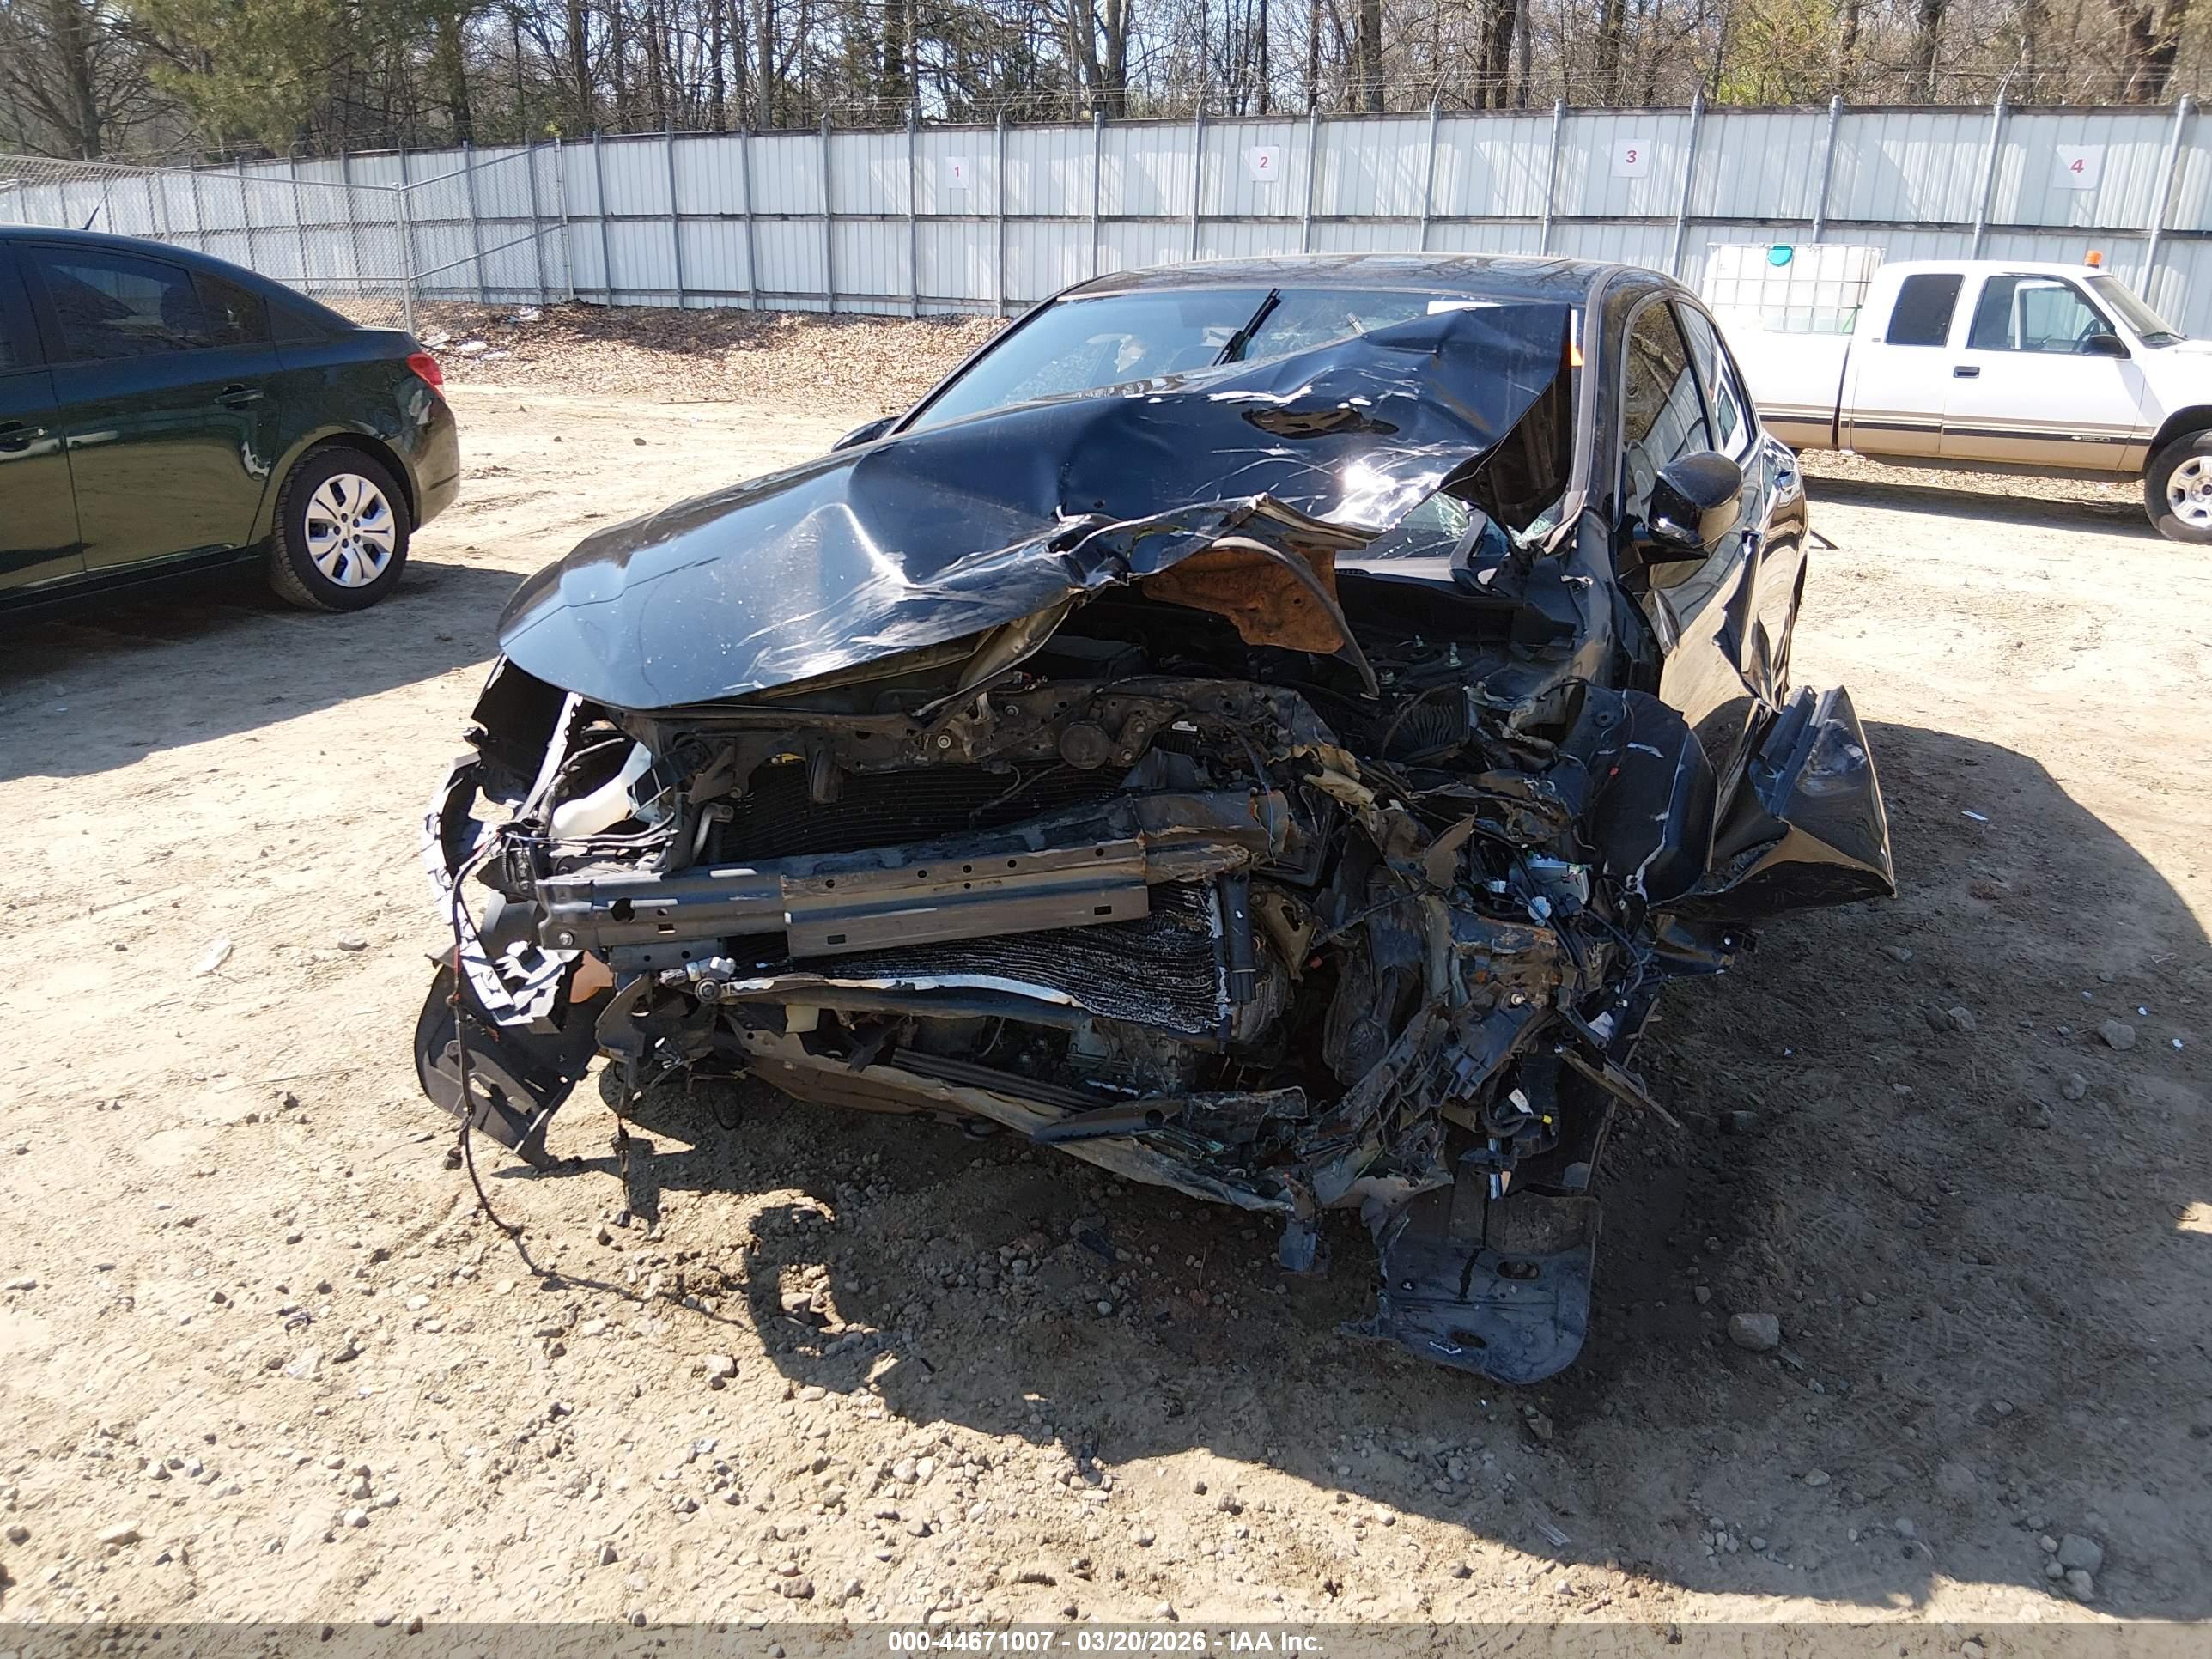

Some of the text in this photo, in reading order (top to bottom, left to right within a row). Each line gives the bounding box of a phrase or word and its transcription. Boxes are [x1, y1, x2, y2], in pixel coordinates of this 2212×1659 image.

[1259, 156, 1268, 168] 2
[1626, 149, 1637, 163] 3
[954, 166, 960, 178] 1
[2069, 159, 2084, 173] 4
